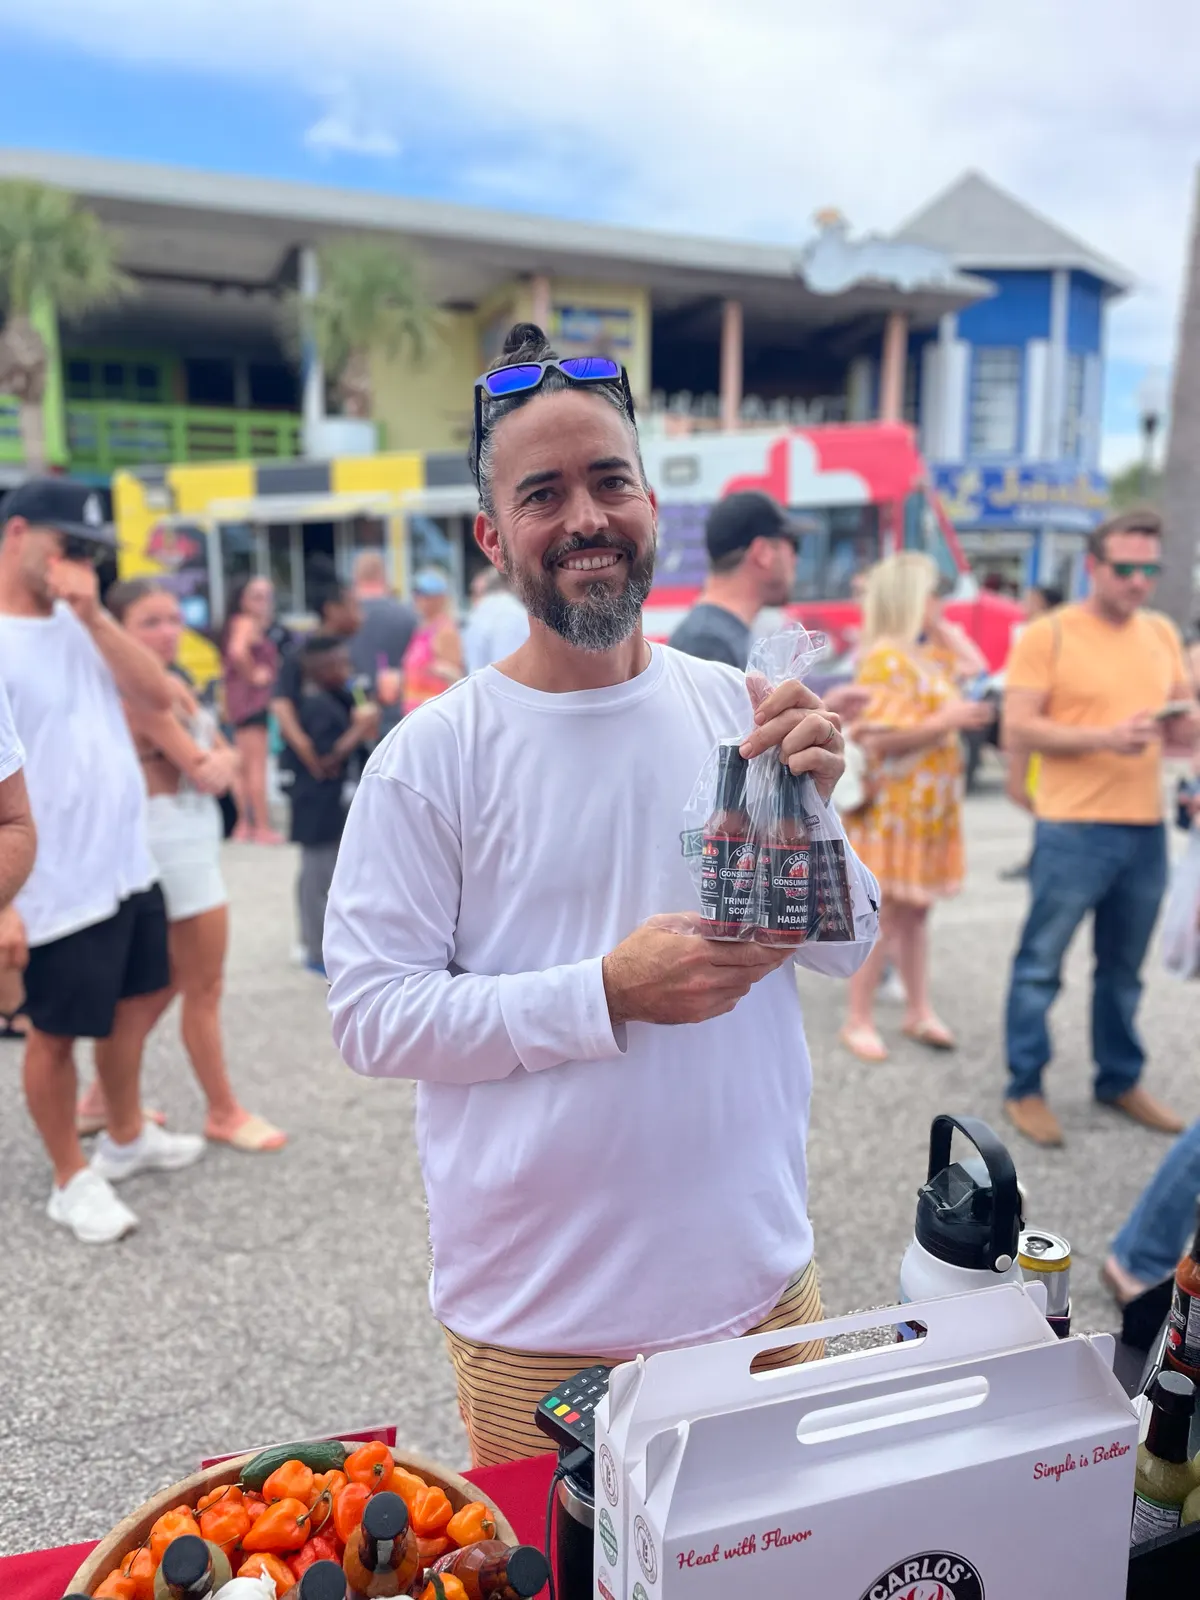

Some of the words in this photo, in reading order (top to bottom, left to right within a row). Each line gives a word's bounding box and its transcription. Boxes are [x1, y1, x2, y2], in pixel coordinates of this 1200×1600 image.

[1033, 1453, 1076, 1482] Simple
[1079, 1454, 1089, 1468] is
[1092, 1441, 1130, 1465] Better
[676, 1544, 720, 1570] Heat
[724, 1534, 757, 1560] with
[760, 1527, 813, 1551] Flavor
